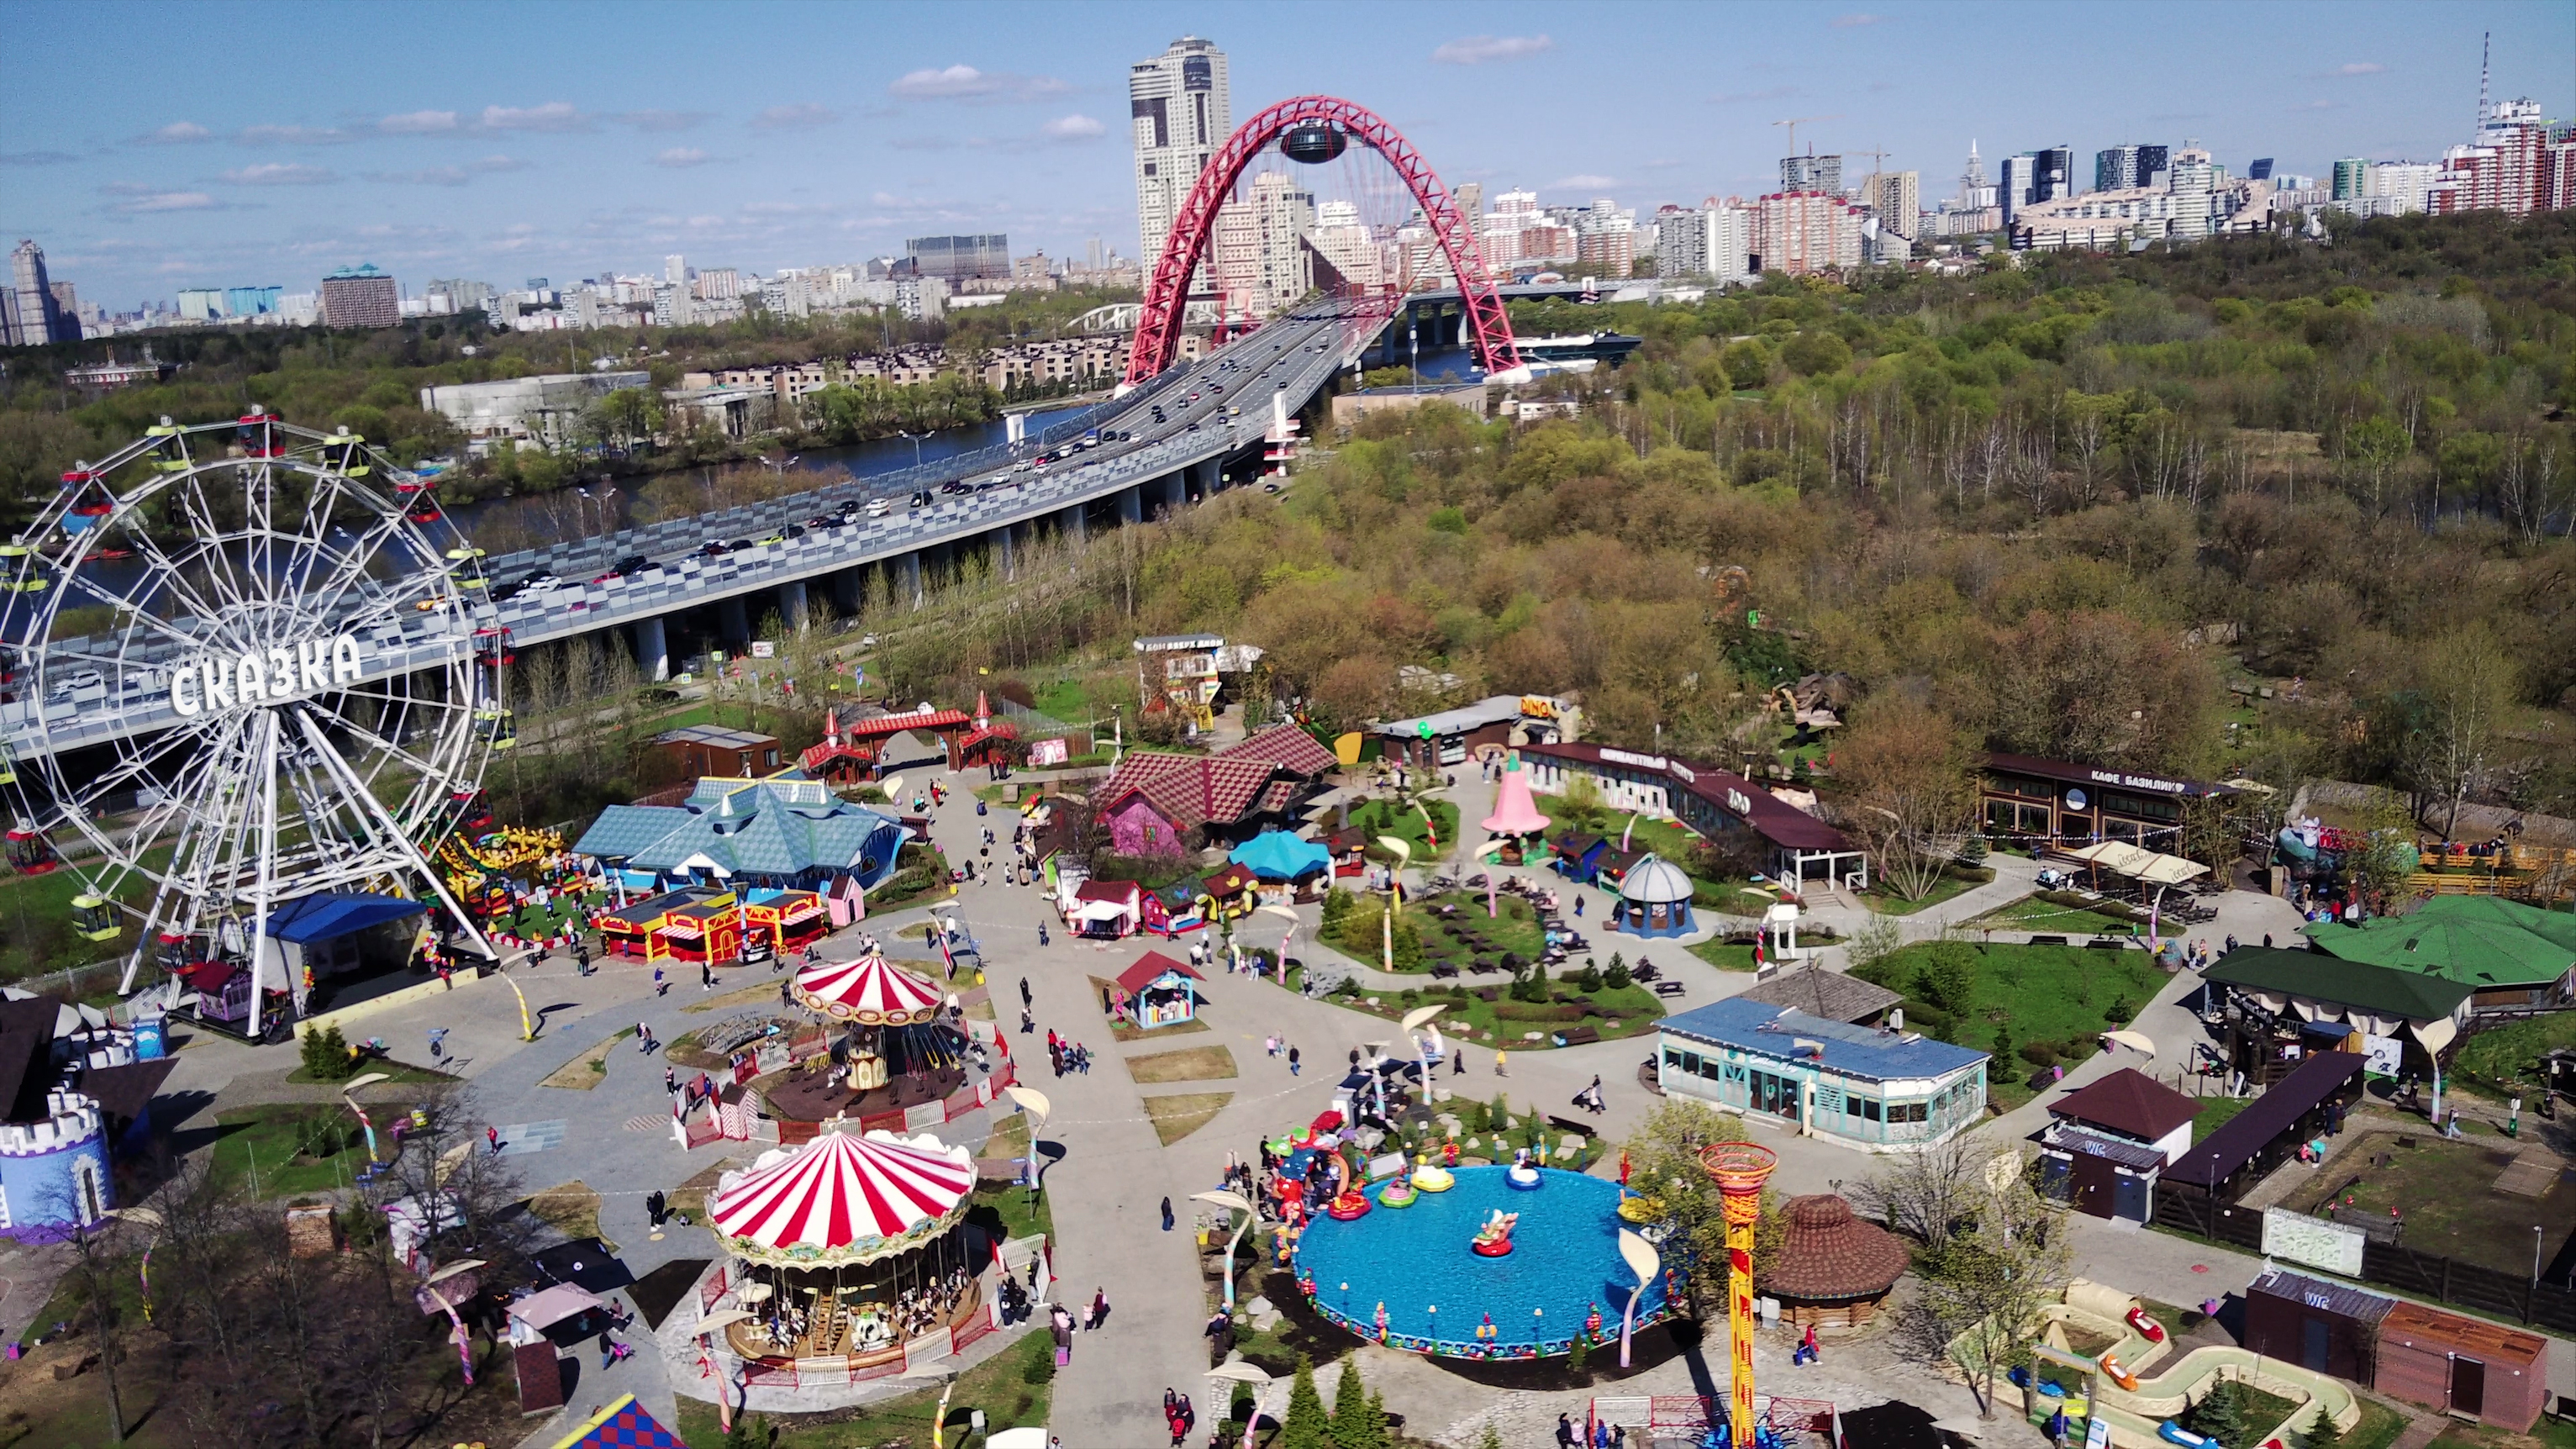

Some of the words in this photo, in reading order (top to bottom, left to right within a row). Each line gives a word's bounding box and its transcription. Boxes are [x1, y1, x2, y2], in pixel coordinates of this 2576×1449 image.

[171, 633, 362, 716] СКАЗКА
[1521, 698, 1550, 717] DINO
[2091, 771, 2120, 783] КАФЕ
[2125, 776, 2175, 792] БАЗИЛИК
[2085, 1140, 2106, 1157] WC
[2305, 1291, 2330, 1310] WC
